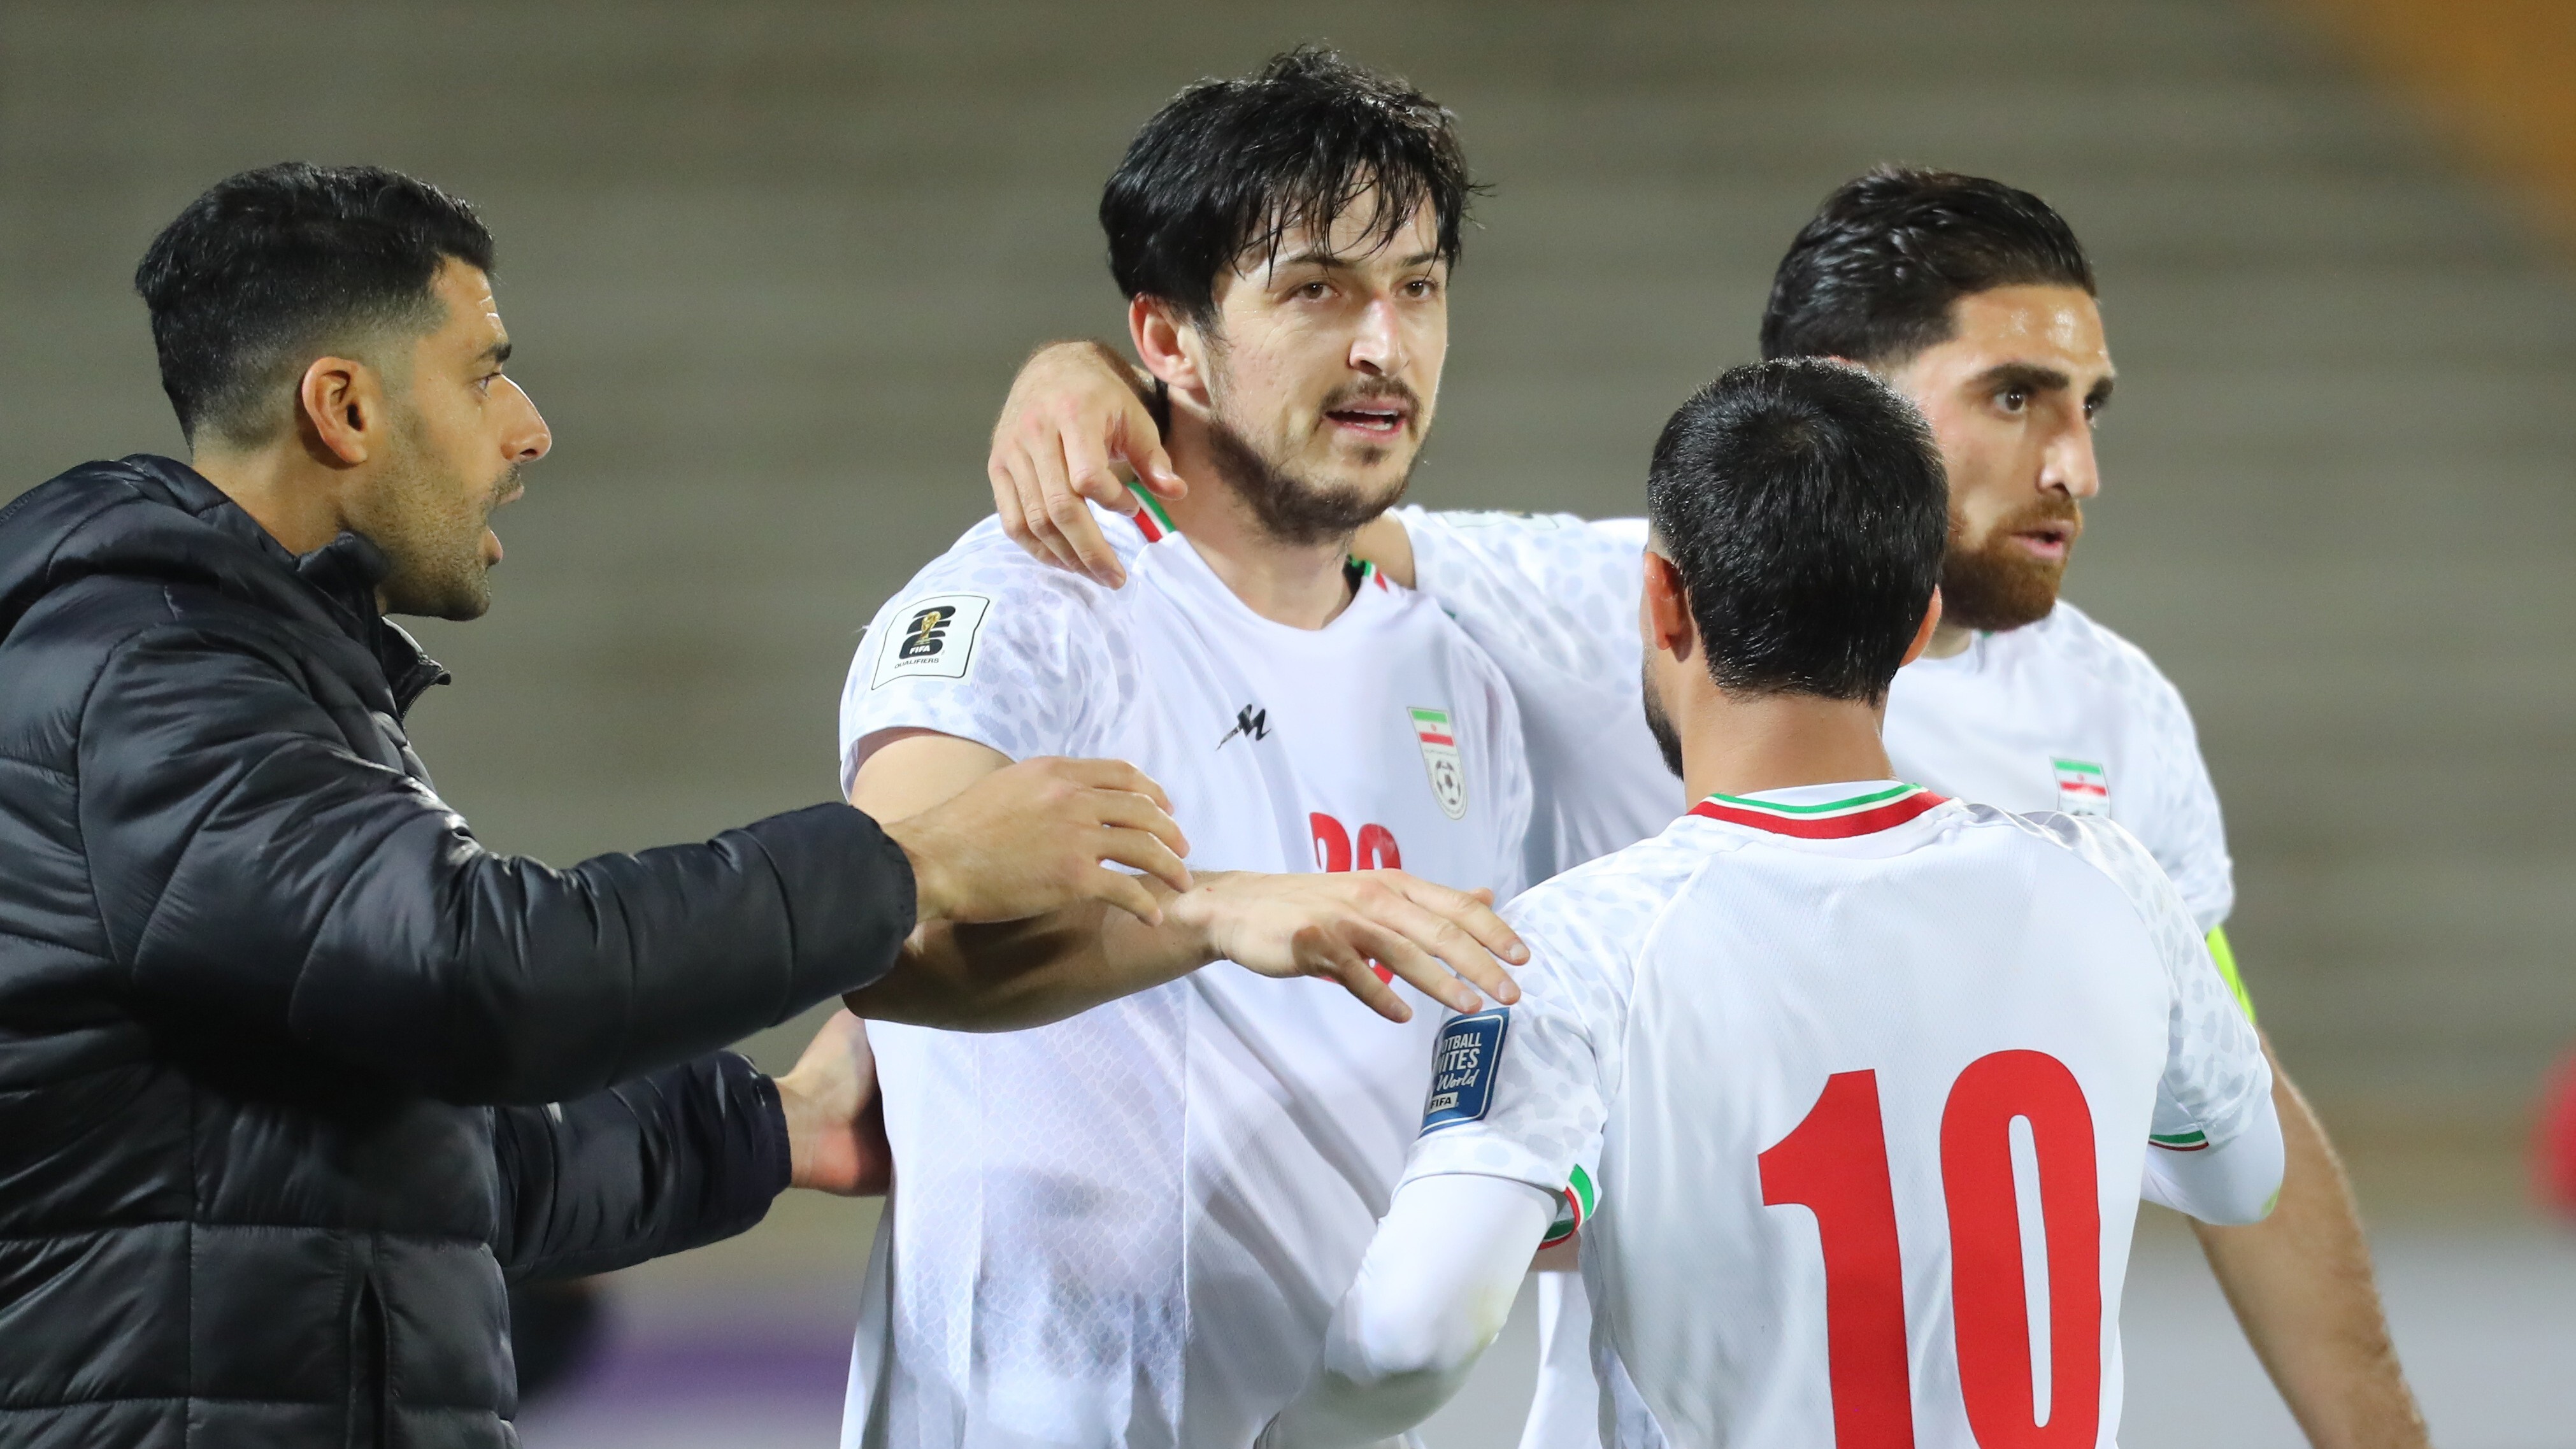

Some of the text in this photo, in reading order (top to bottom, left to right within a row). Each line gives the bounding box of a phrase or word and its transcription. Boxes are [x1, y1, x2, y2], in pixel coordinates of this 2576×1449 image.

[909, 645, 931, 655] FIFA
[894, 657, 940, 669] QUALIFIERS
[1442, 1032, 1482, 1053] OTBALL
[1436, 1069, 1480, 1091] World
[1431, 1097, 1452, 1109] FIFA
[1758, 1049, 2101, 1449] 10
